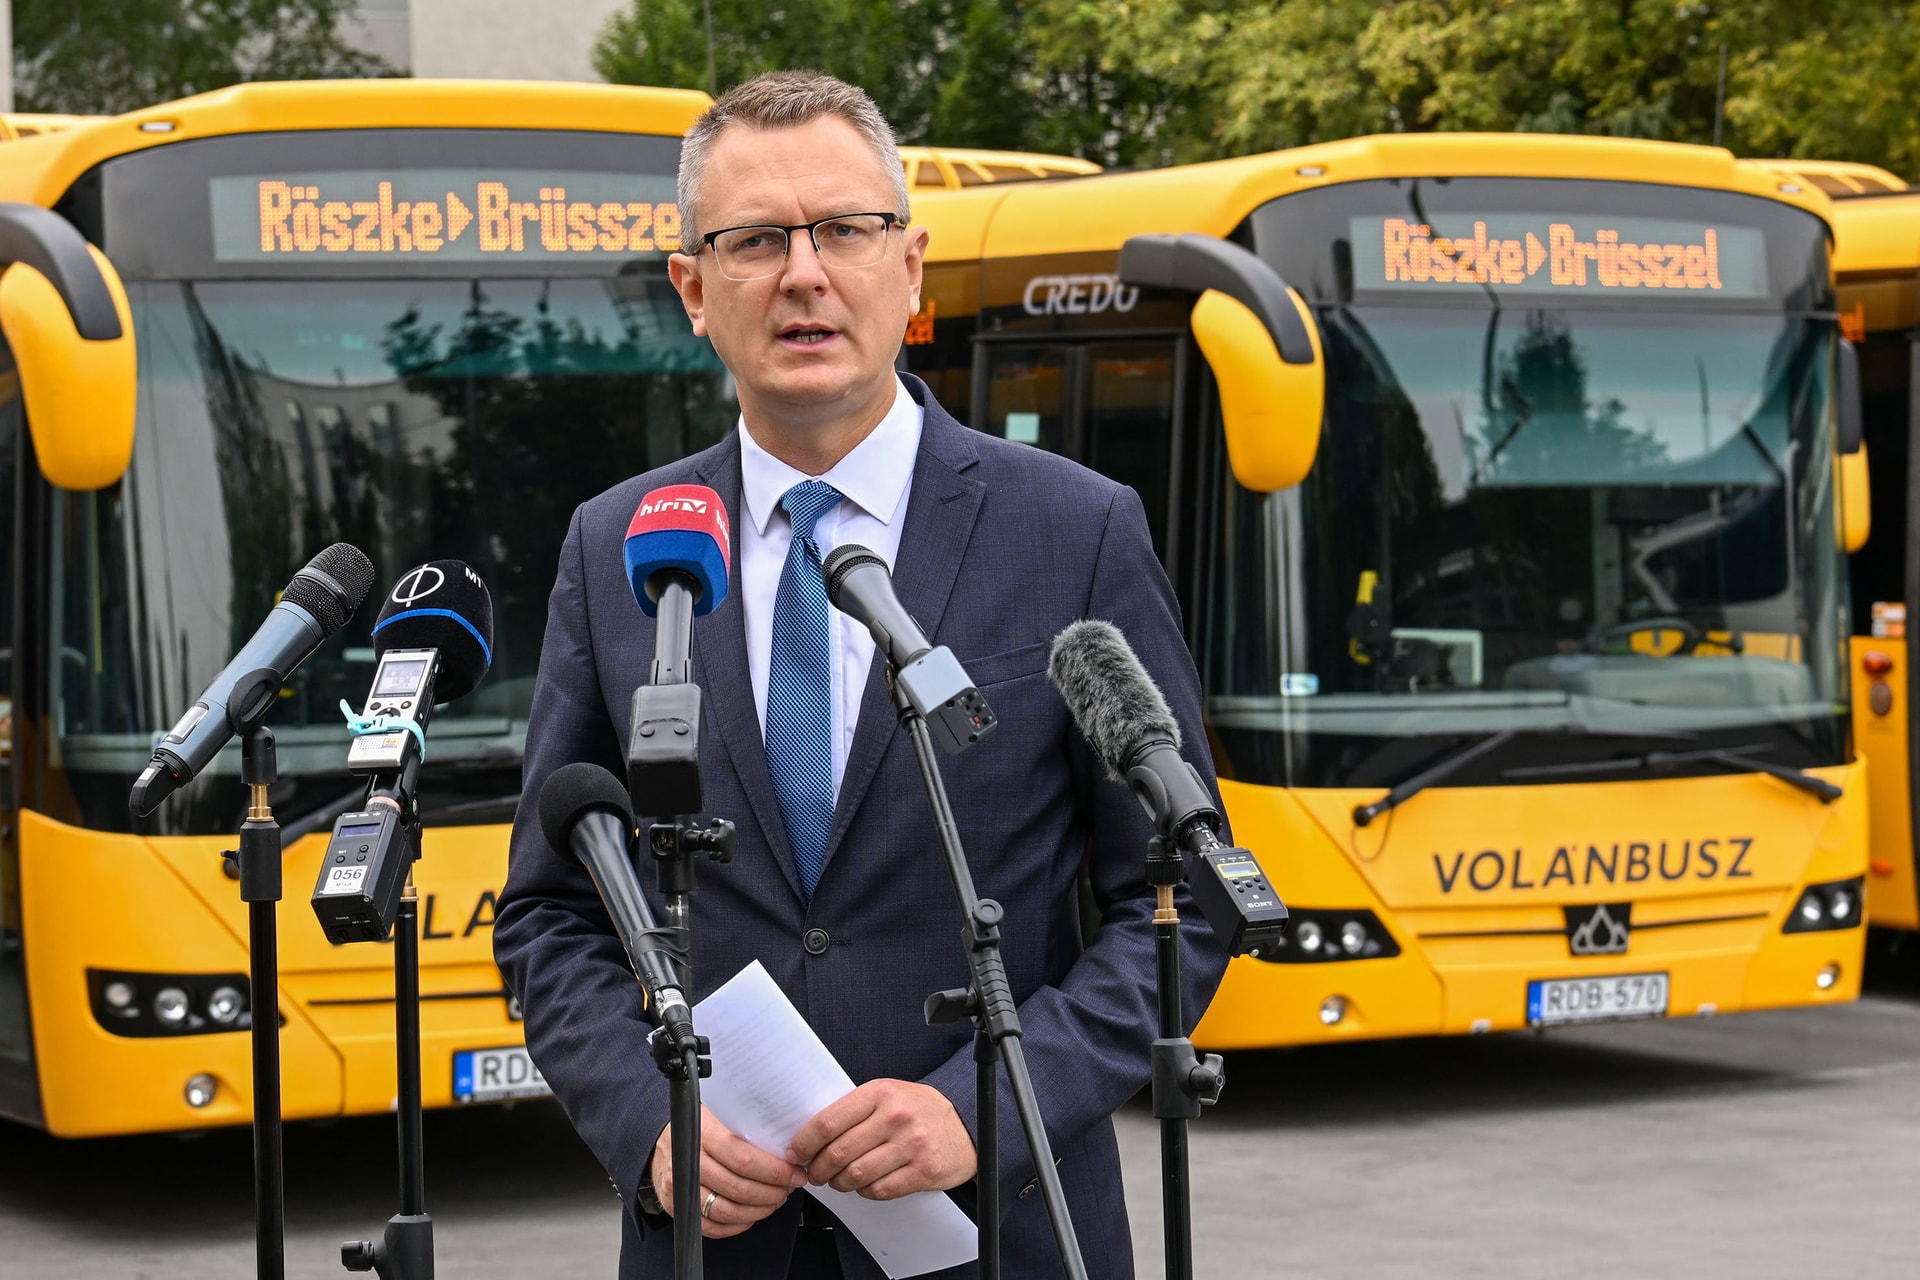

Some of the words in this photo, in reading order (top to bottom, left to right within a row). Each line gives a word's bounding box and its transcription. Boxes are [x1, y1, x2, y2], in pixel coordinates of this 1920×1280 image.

[259, 181, 444, 252] Röszke
[477, 182, 682, 252] Brüssze
[1384, 219, 1526, 284] Röszke
[1549, 224, 1722, 289] Brüsszel
[465, 566, 482, 588] M1
[333, 868, 363, 881] 056
[1547, 976, 1661, 1012] RDB-570
